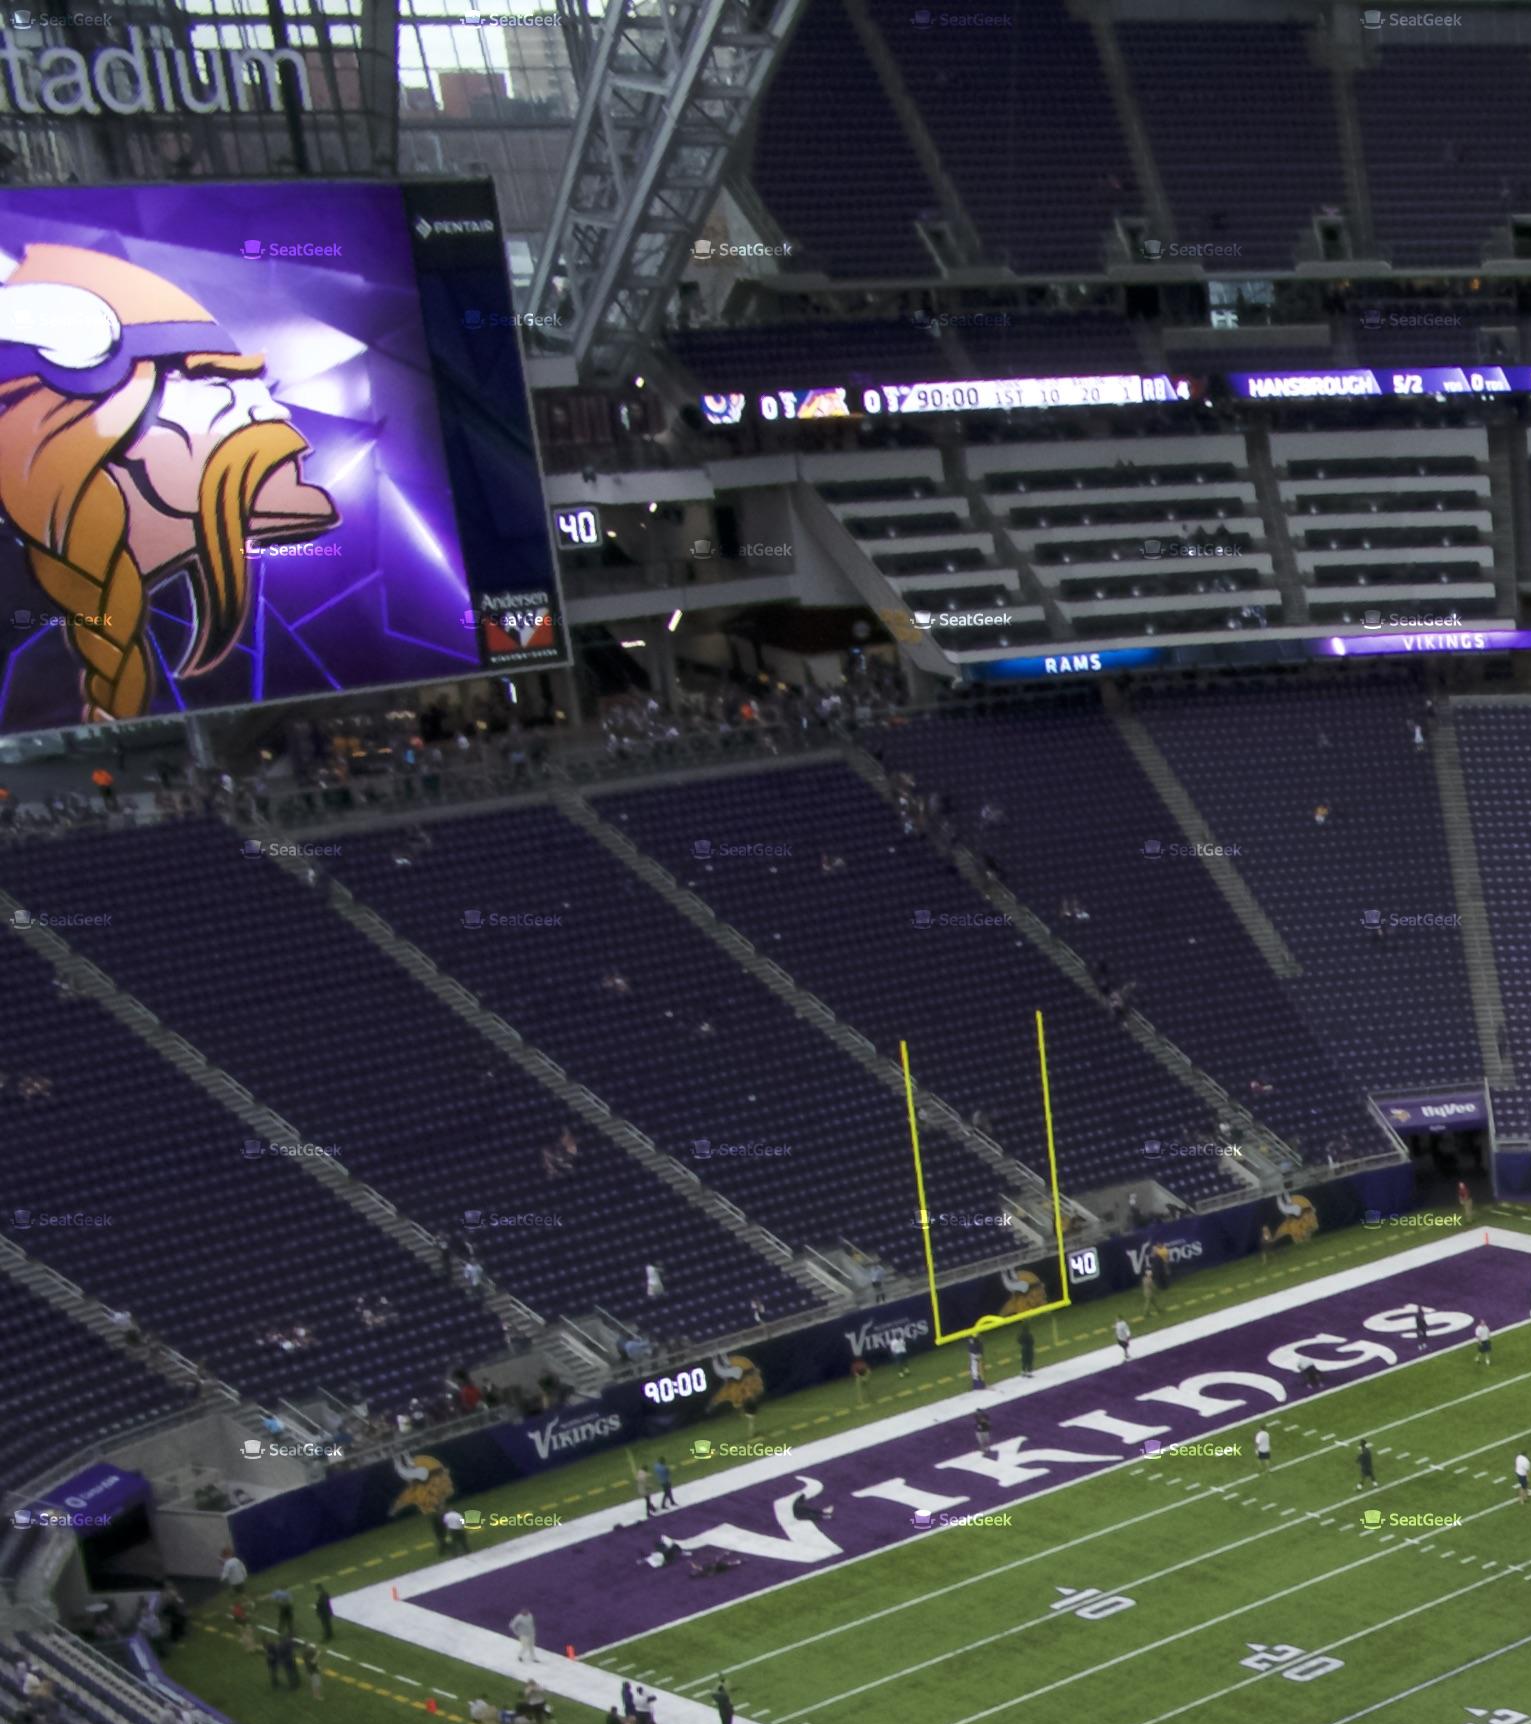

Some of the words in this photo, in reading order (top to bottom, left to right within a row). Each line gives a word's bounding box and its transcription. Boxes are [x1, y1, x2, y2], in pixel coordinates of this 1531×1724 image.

[433, 218, 495, 235] PENTAIR
[917, 387, 979, 410] 90:00
[1040, 389, 1060, 404] 10
[1082, 387, 1101, 403] 20
[1248, 376, 1373, 398] HANSBROUGH
[1393, 374, 1422, 394] 5/2
[558, 510, 598, 543] 40
[481, 590, 549, 611] Andersen
[1402, 633, 1486, 651] VIKINGS
[1044, 653, 1102, 674] RAMS
[1070, 1251, 1097, 1276] 40
[844, 1317, 929, 1357] VIKINGS
[644, 1367, 707, 1404] 90:00
[527, 1413, 622, 1460] VIKINGS
[678, 1304, 1474, 1563] VIKINGS
[1049, 1588, 1137, 1620] 10
[1238, 1643, 1345, 1682] 20
